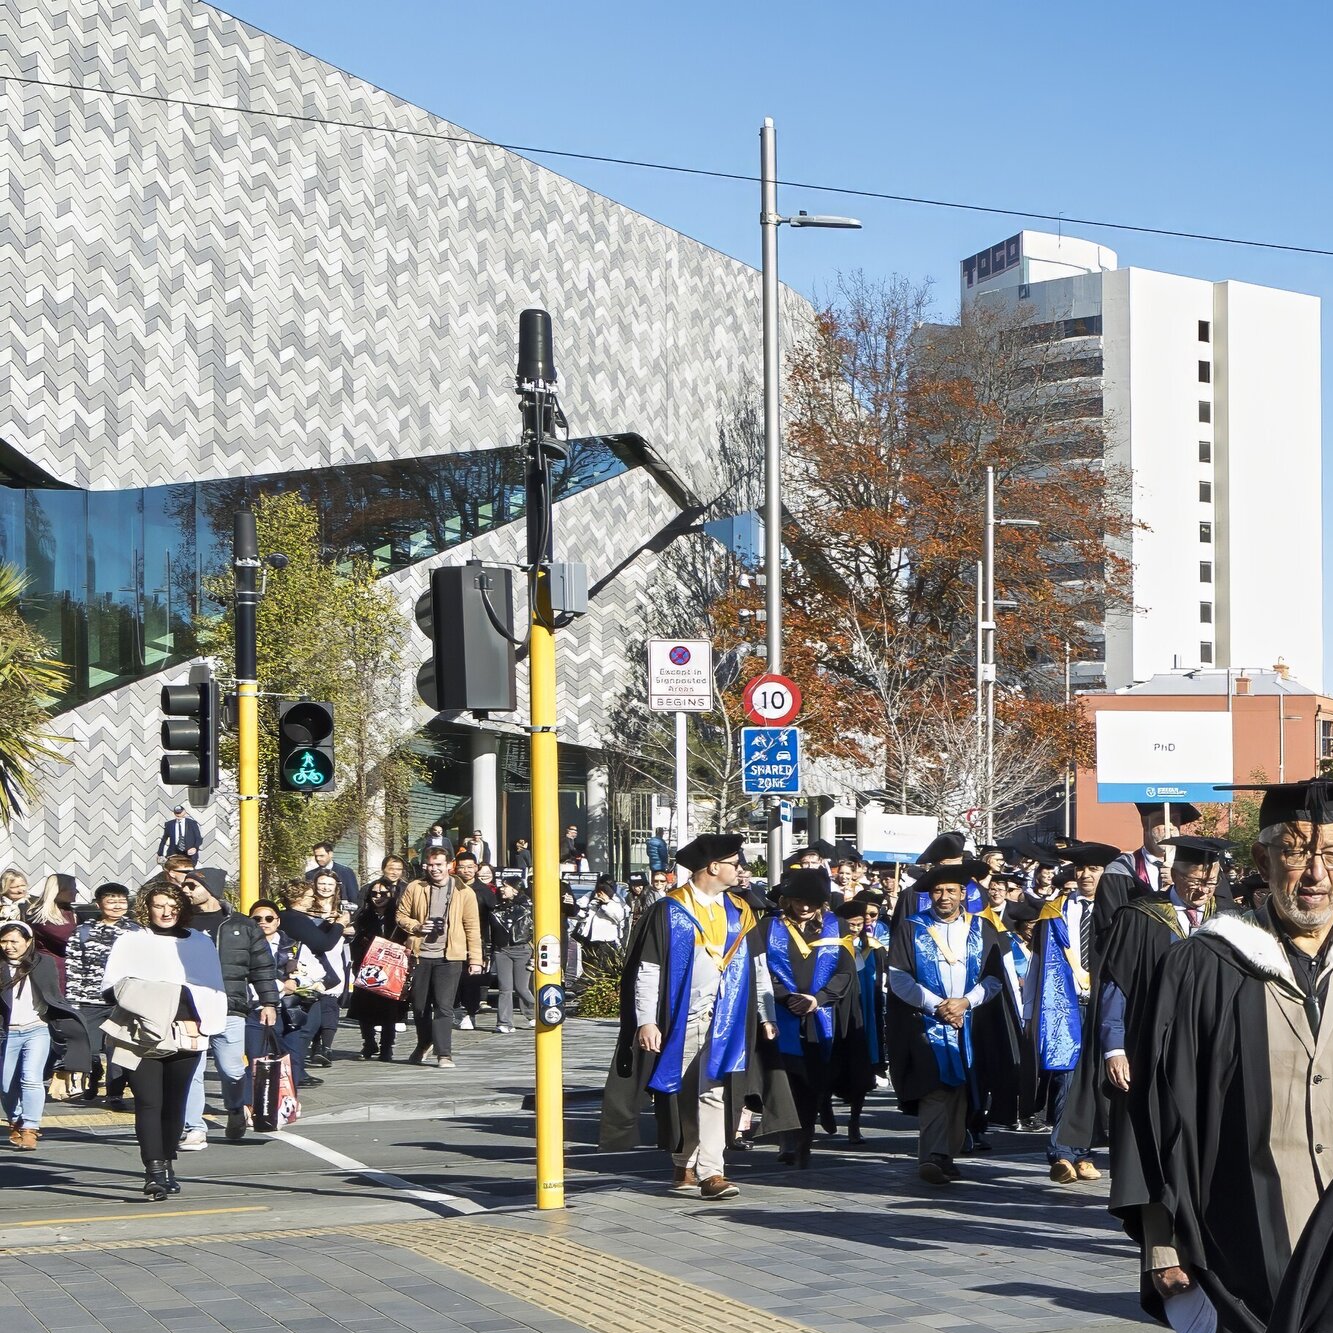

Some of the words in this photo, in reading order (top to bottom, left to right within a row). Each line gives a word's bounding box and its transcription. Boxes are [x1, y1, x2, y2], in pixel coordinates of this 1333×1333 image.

[657, 698, 705, 707] BEGINS
[761, 691, 785, 709] 10
[1153, 743, 1176, 752] PhD
[750, 765, 793, 776] SHARED
[757, 778, 787, 788] ZONE
